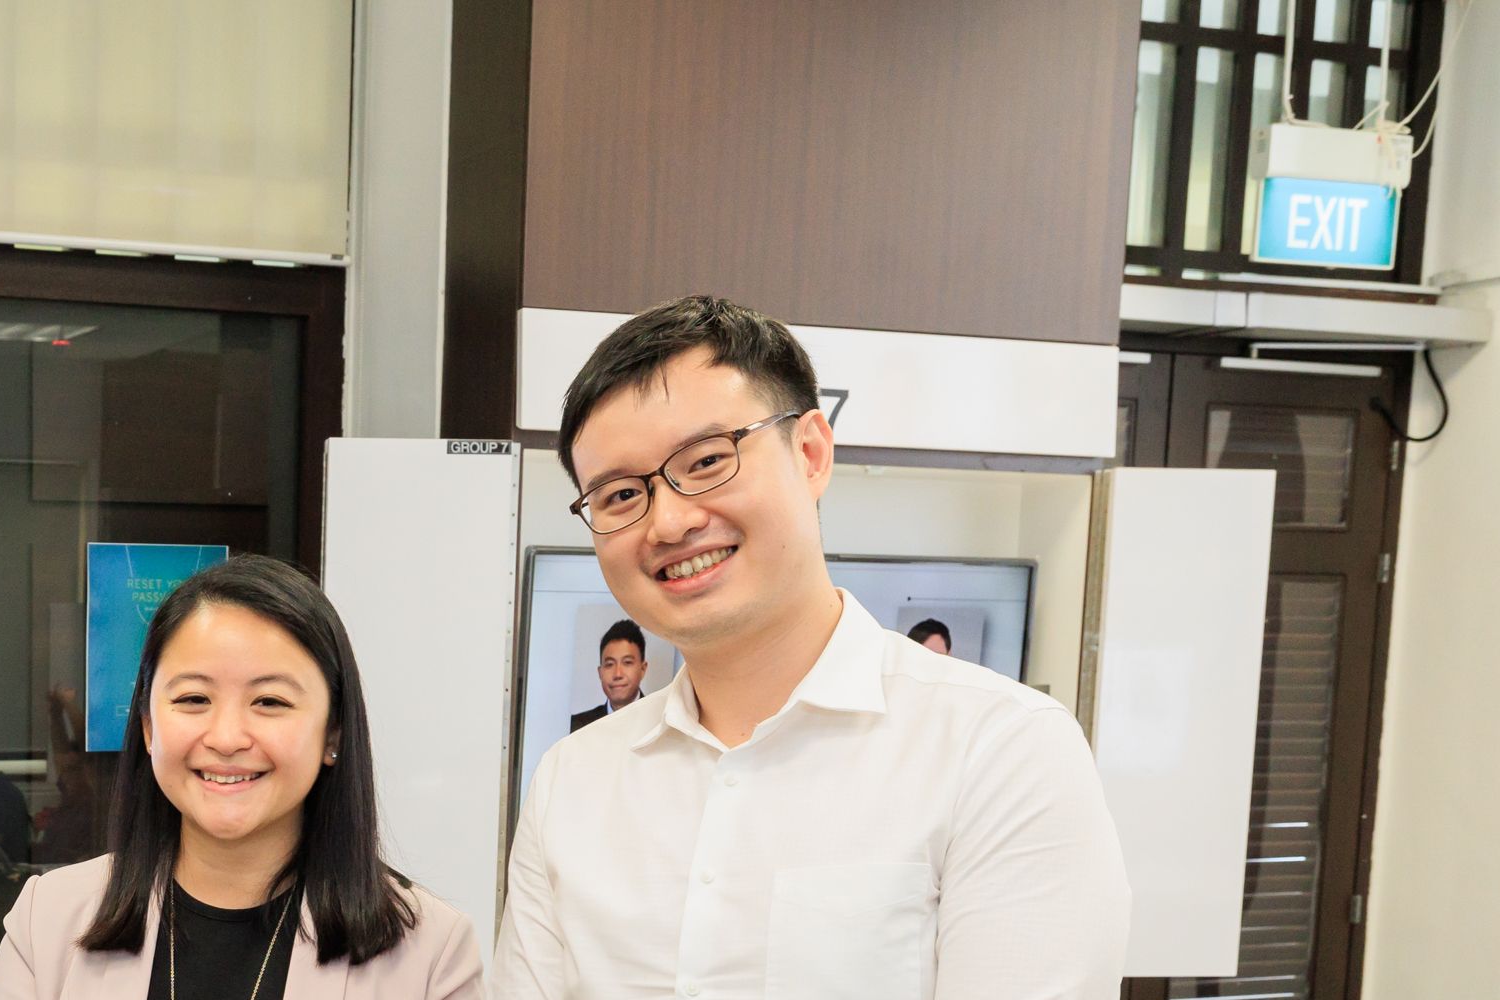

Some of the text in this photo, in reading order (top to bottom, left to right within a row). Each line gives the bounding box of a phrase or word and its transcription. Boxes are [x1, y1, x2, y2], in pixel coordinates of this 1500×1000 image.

[1286, 194, 1369, 252] EXIT
[819, 388, 849, 430] 7
[451, 441, 509, 454] GROUP 7
[126, 578, 163, 590] RESET
